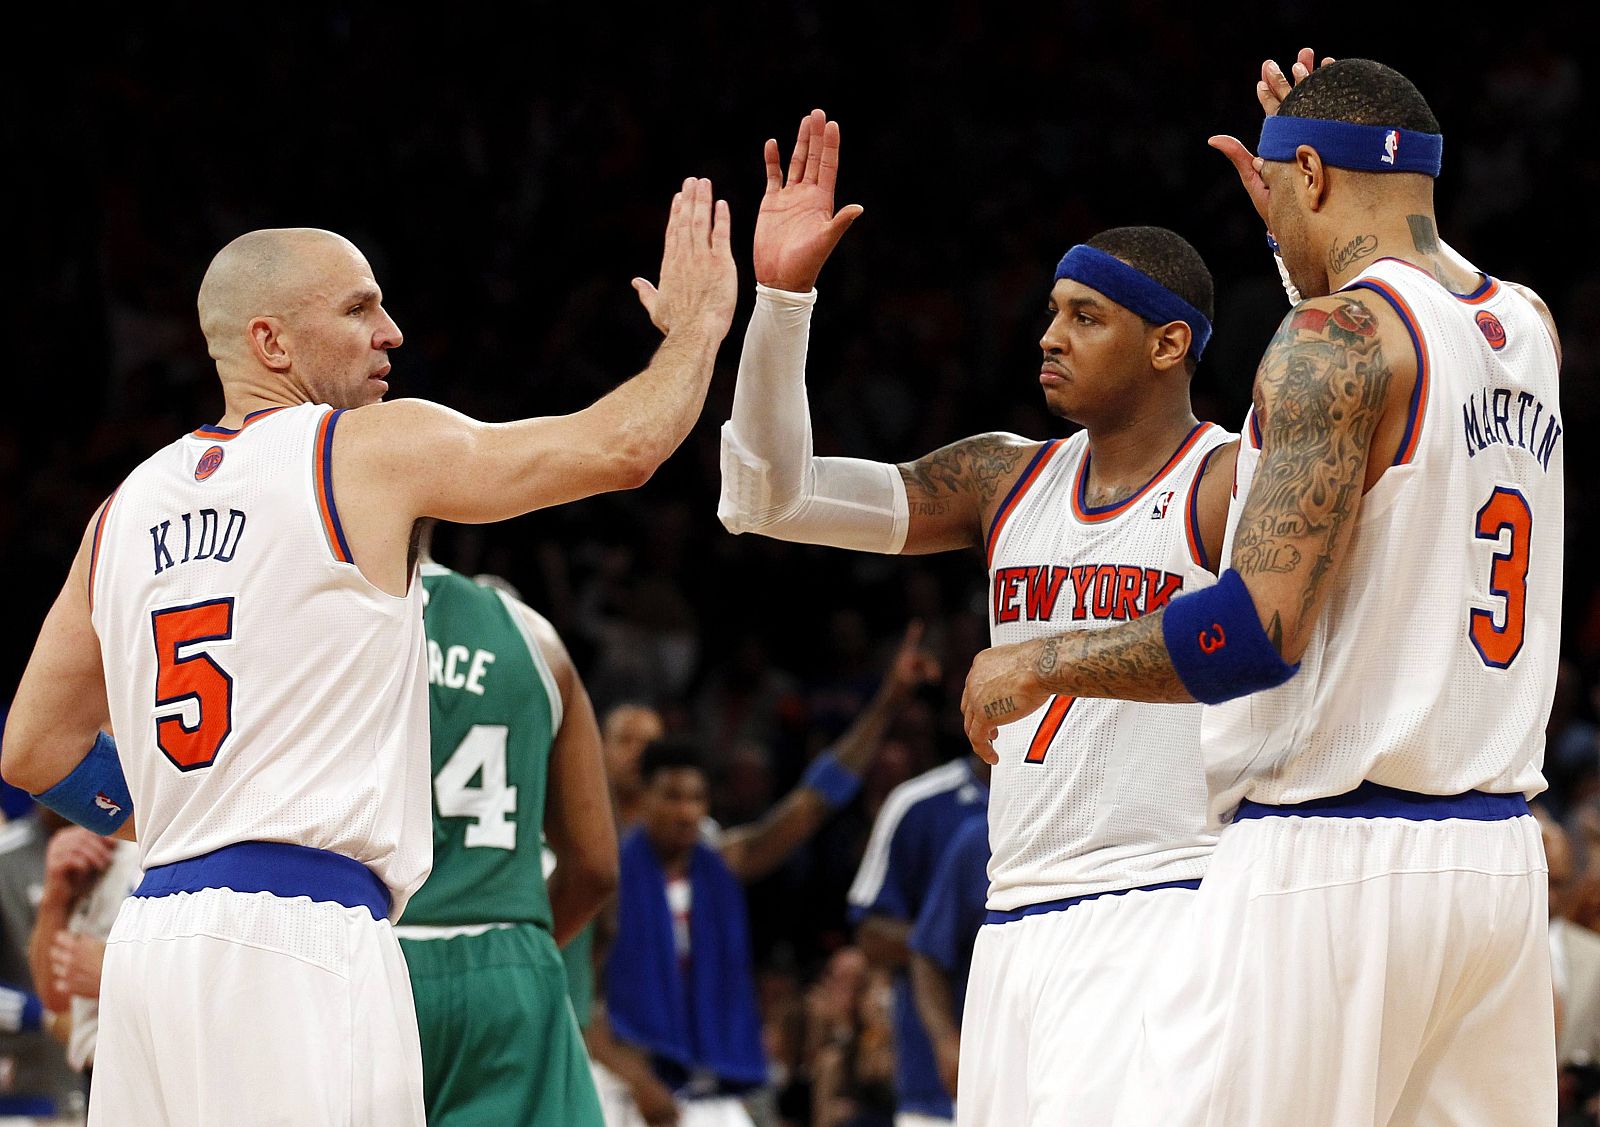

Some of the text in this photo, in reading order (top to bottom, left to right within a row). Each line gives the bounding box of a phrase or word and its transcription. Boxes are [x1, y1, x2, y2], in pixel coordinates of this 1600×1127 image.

[1463, 387, 1562, 473] MARTIN
[150, 509, 246, 575] KIDD
[1469, 486, 1532, 670] 3
[1071, 564, 1184, 621] YORK
[427, 639, 496, 695] RCE
[1198, 623, 1227, 655] 3
[151, 596, 235, 773] 5
[433, 724, 518, 850] 4
